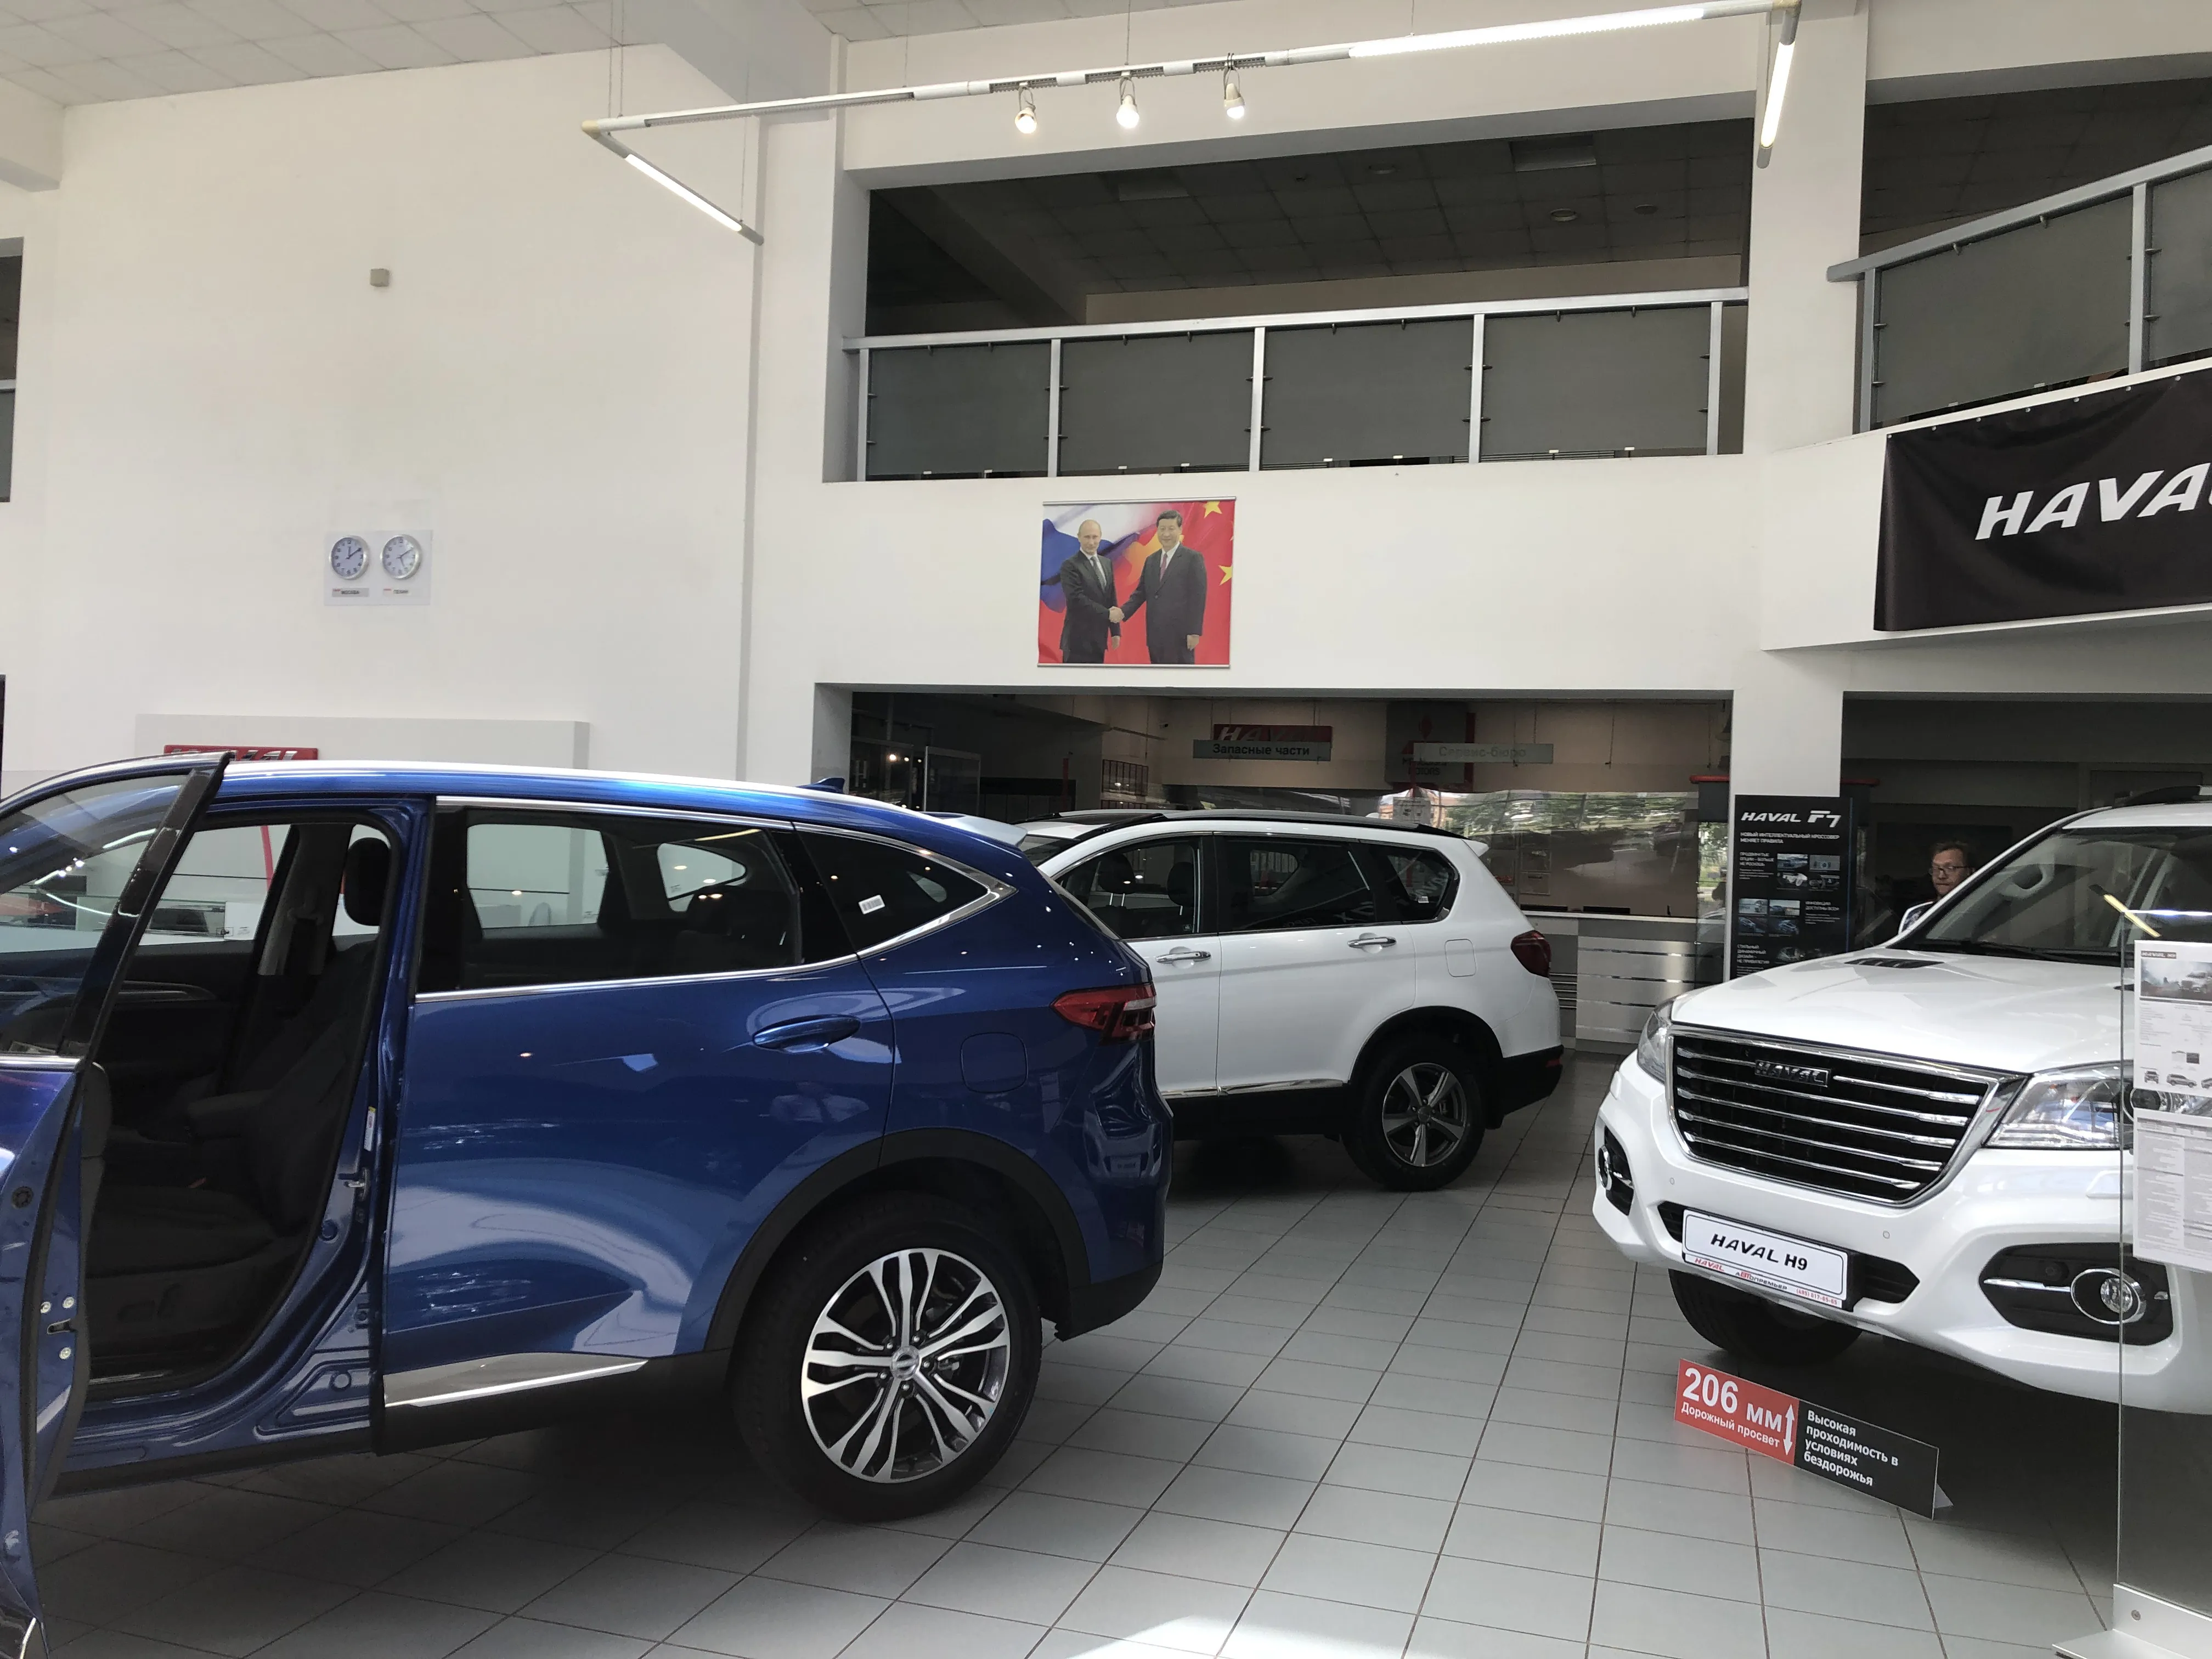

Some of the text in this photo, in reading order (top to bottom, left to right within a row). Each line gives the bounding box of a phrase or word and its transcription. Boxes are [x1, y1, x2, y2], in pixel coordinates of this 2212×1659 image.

[1975, 462, 2212, 540] HAVA
[1213, 743, 1310, 755] Запасные части
[1438, 746, 1527, 759] Сервис-бюро
[1741, 810, 1842, 828] HAVAL F7
[1694, 1257, 1724, 1272] HAVAL
[1711, 1233, 1808, 1271] HAVAL H9
[1683, 1367, 1782, 1432] 206 мм
[1681, 1401, 1781, 1448] Дорожный просвет
[1807, 1409, 1857, 1436] Высокая
[1805, 1438, 1858, 1466] условиях
[1806, 1425, 1899, 1466] проходимость в
[1804, 1451, 1874, 1487] бездорожья
